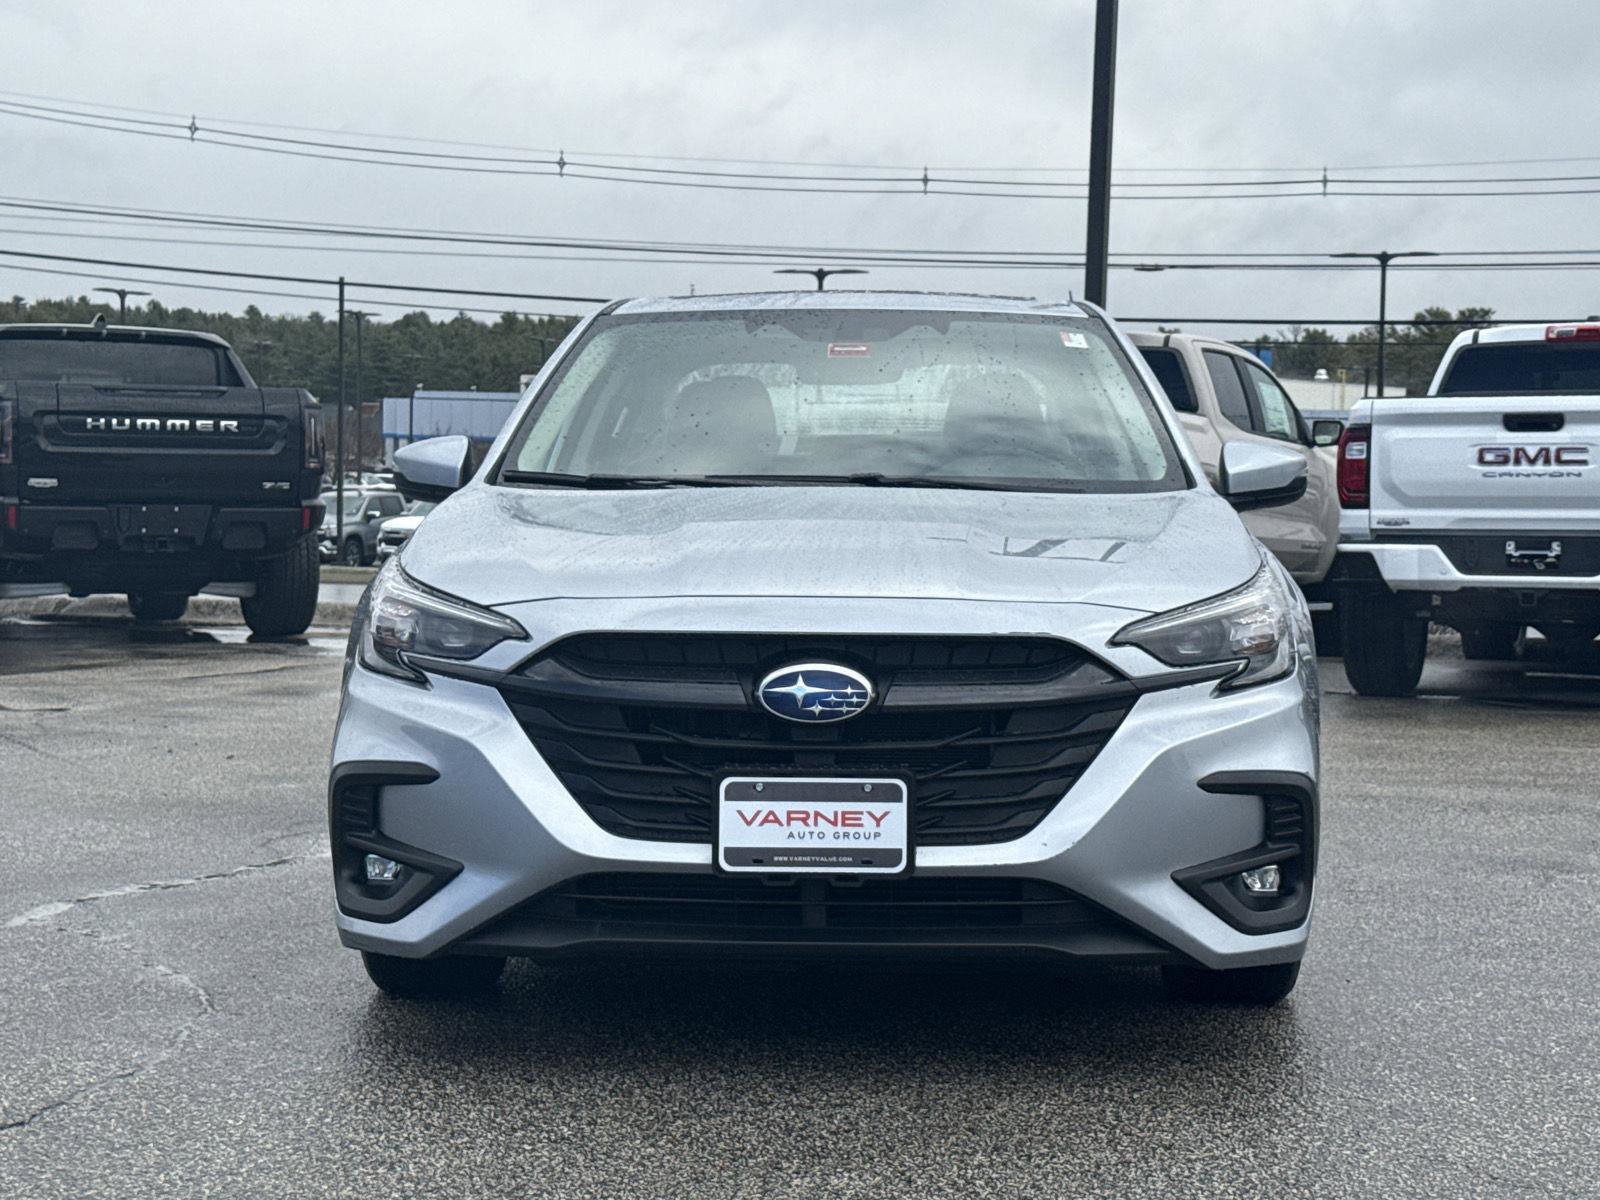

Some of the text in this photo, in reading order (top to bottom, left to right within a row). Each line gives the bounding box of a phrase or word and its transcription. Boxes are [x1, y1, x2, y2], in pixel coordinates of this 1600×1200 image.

[86, 417, 239, 432] HUMMER
[1477, 447, 1589, 466] GMC
[736, 809, 891, 828] VARNEY
[787, 831, 882, 840] AUTO GROUP
